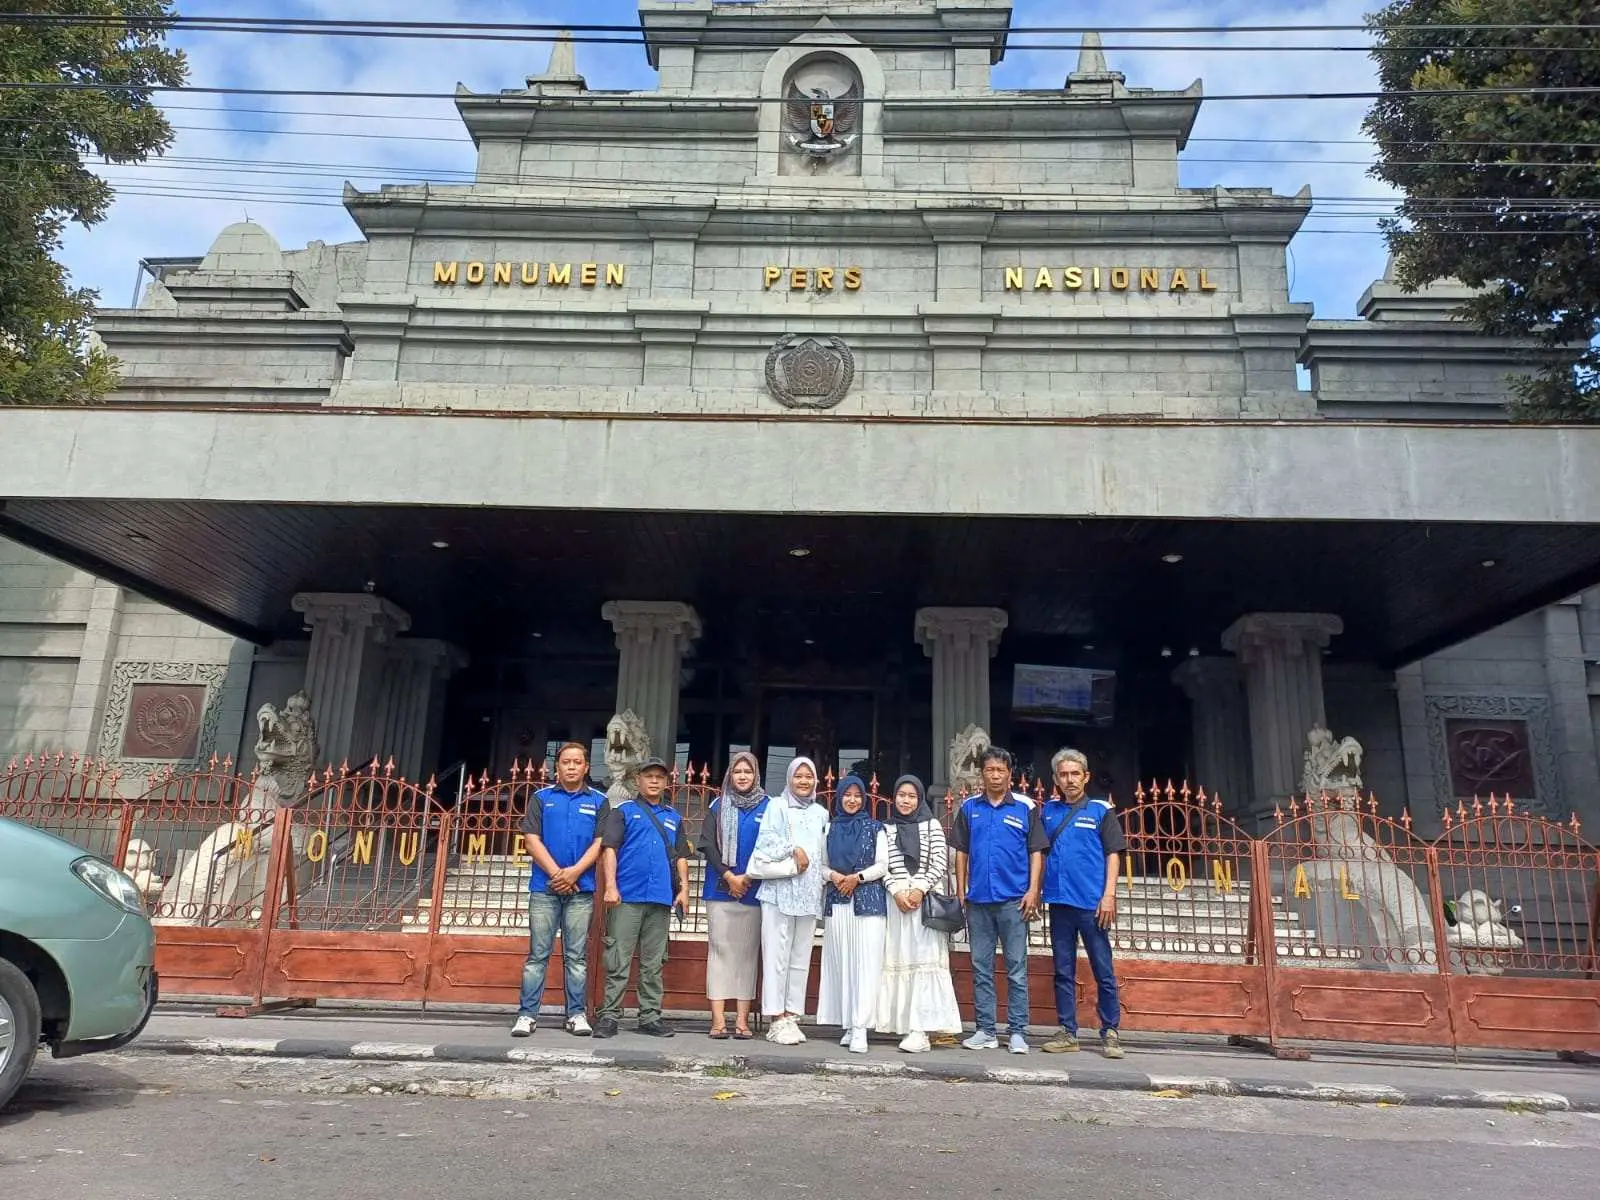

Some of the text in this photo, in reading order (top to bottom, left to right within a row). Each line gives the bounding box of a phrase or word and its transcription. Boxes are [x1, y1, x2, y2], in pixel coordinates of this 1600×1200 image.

[433, 260, 1217, 291] MONUMEN PERS NASIONAL
